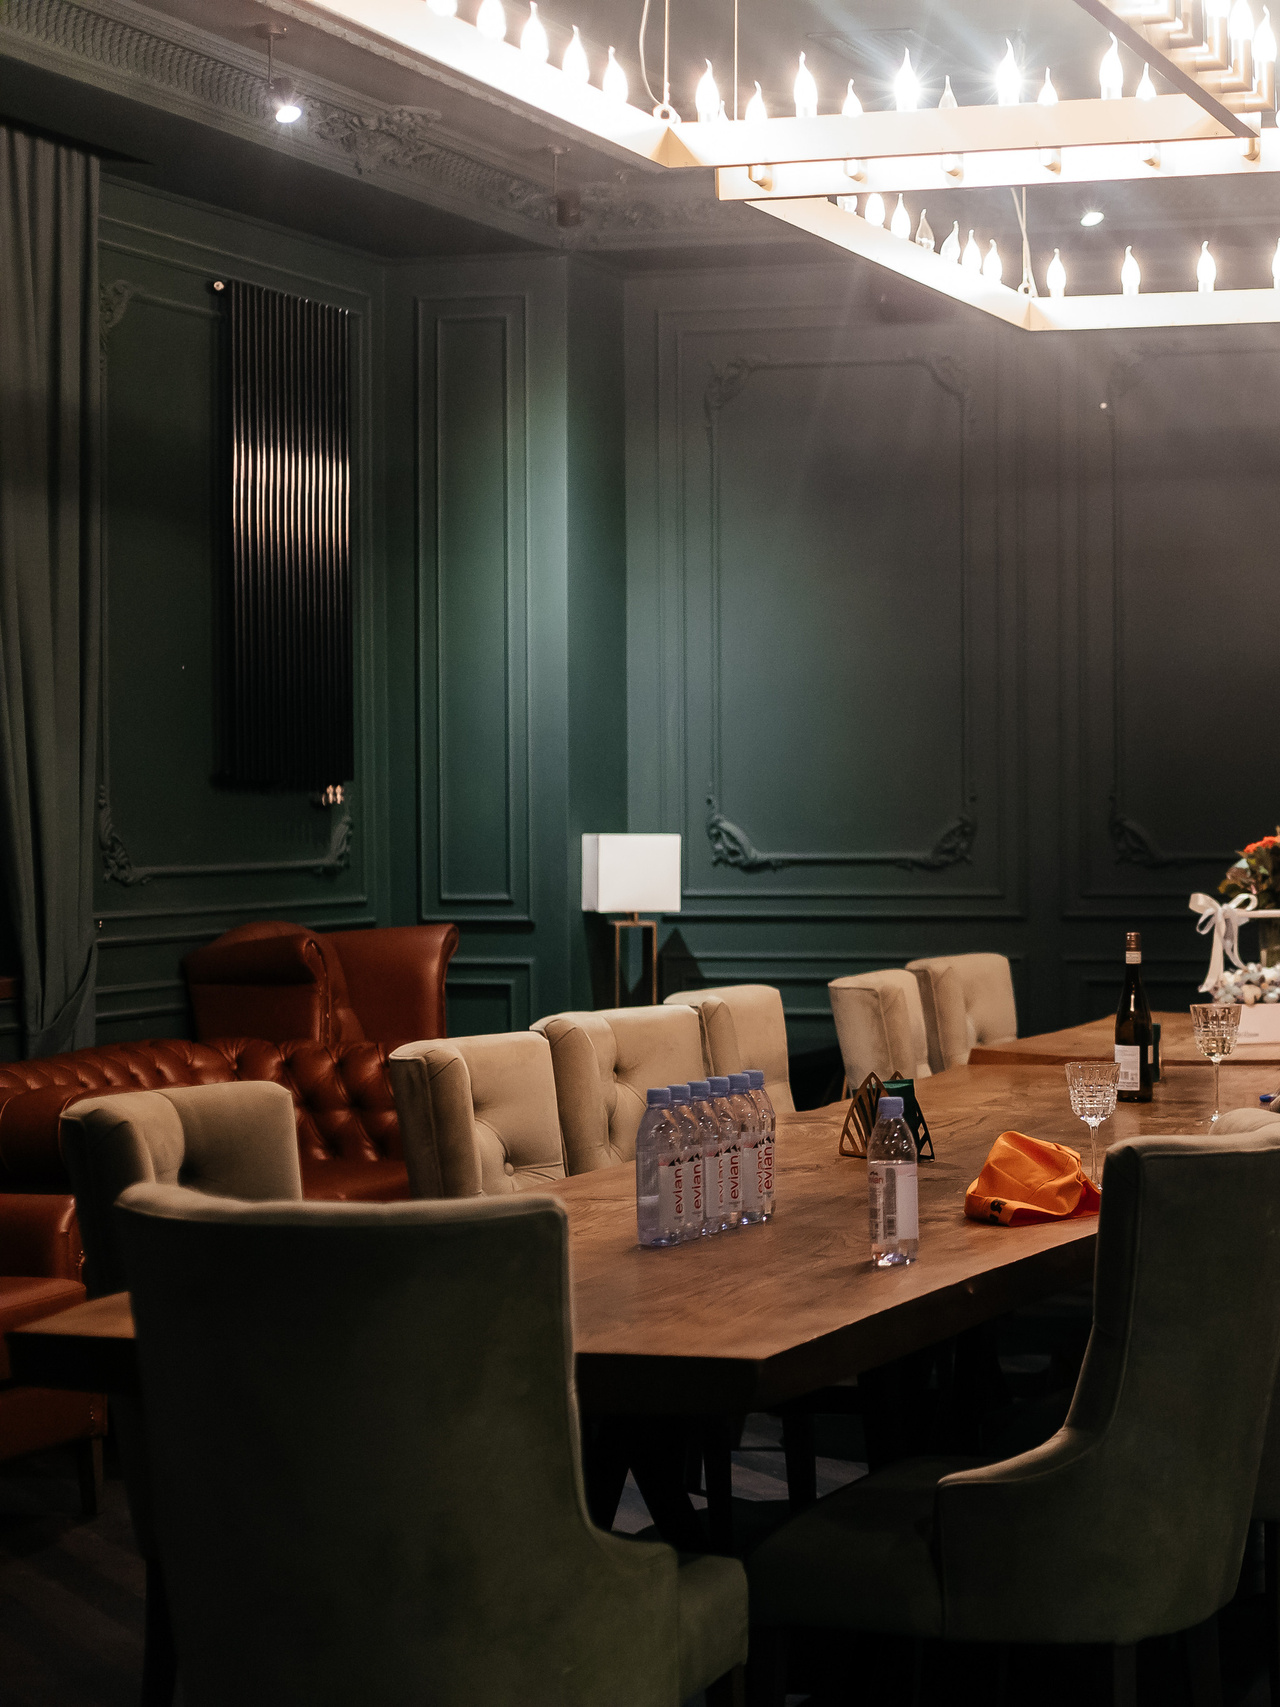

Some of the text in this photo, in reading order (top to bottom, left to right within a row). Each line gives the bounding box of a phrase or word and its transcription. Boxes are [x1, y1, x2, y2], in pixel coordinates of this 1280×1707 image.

[692, 1164, 702, 1209] evian
[728, 1155, 740, 1199] evian
[762, 1146, 773, 1190] evian
[673, 1168, 684, 1214] evian
